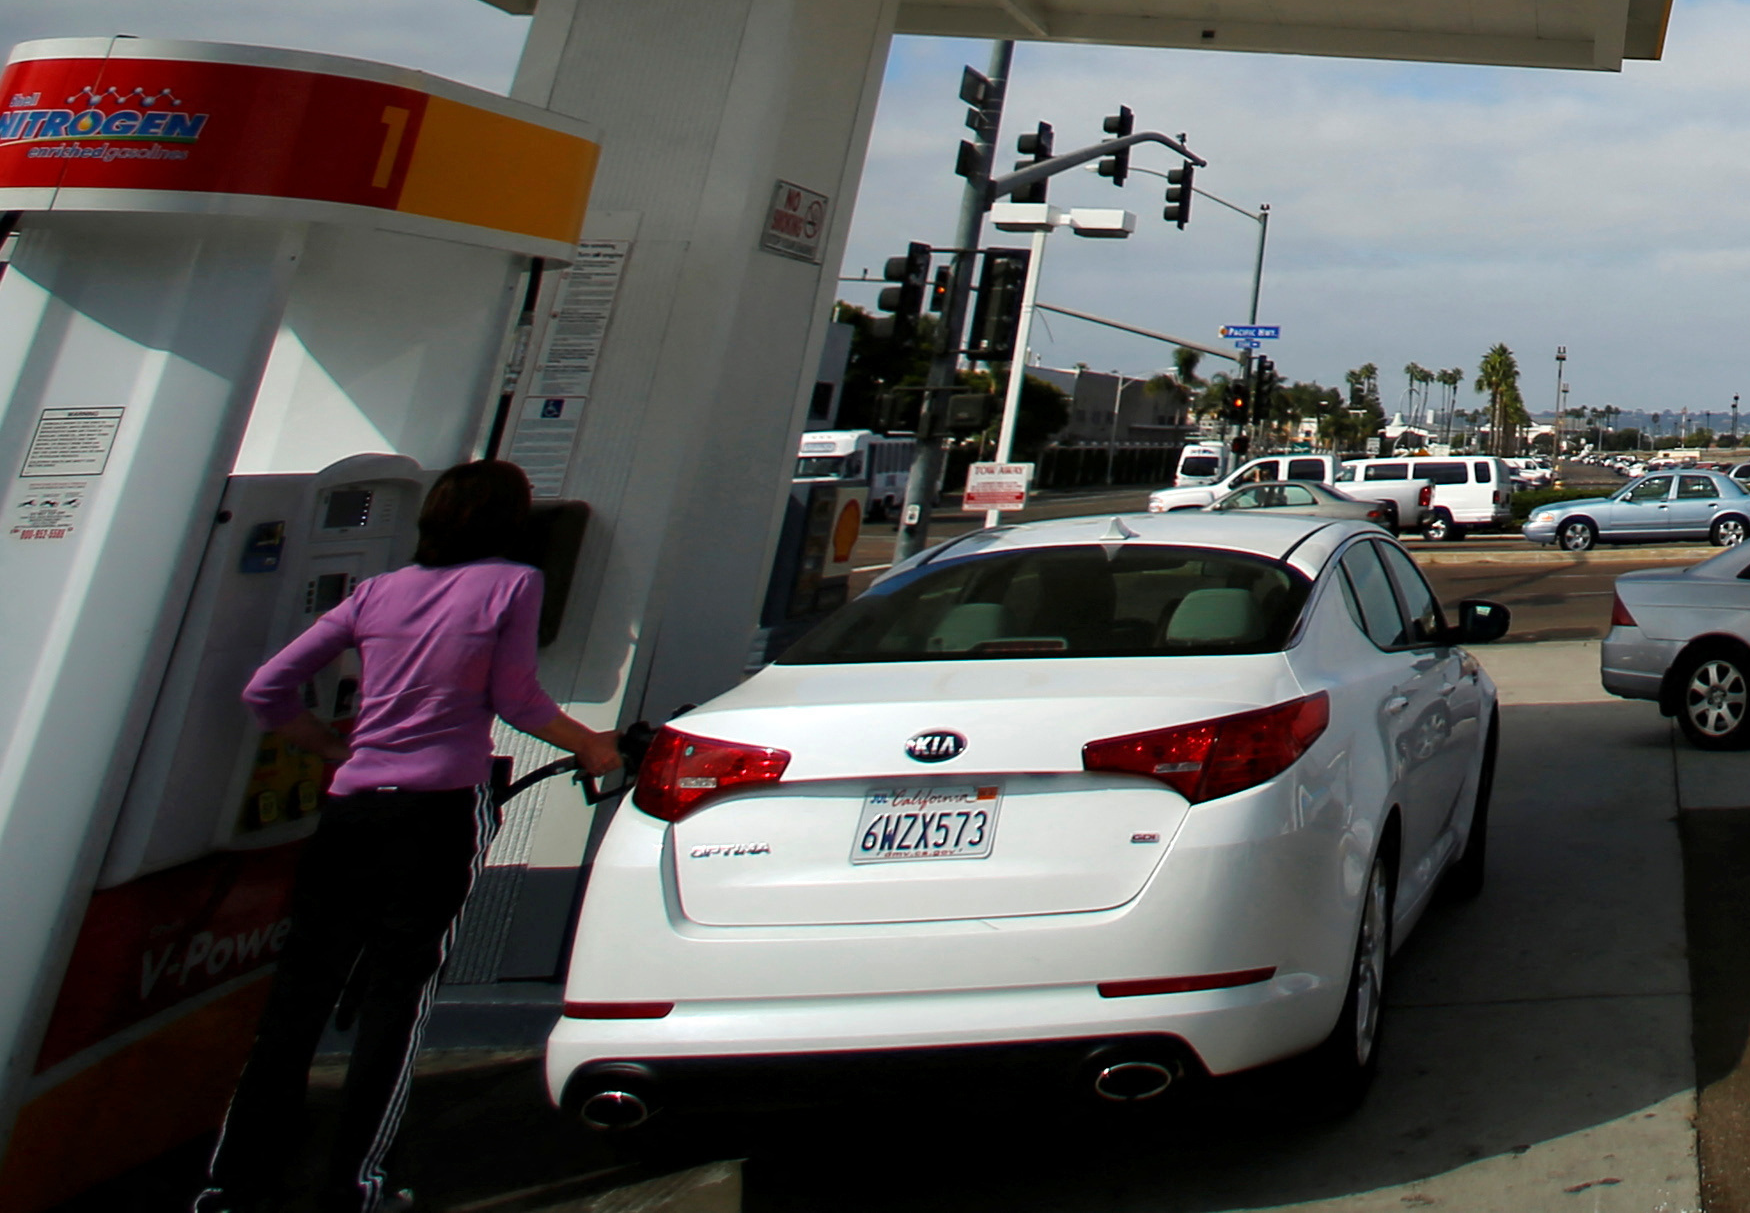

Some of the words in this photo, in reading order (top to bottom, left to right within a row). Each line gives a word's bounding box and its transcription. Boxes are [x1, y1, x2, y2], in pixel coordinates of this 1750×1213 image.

[371, 105, 411, 189] 1
[914, 735, 956, 756] KIA
[892, 788, 978, 811] California
[861, 810, 989, 852] 6WZX573
[690, 842, 772, 859] OPTIMA
[139, 916, 293, 1001] V-Powe
